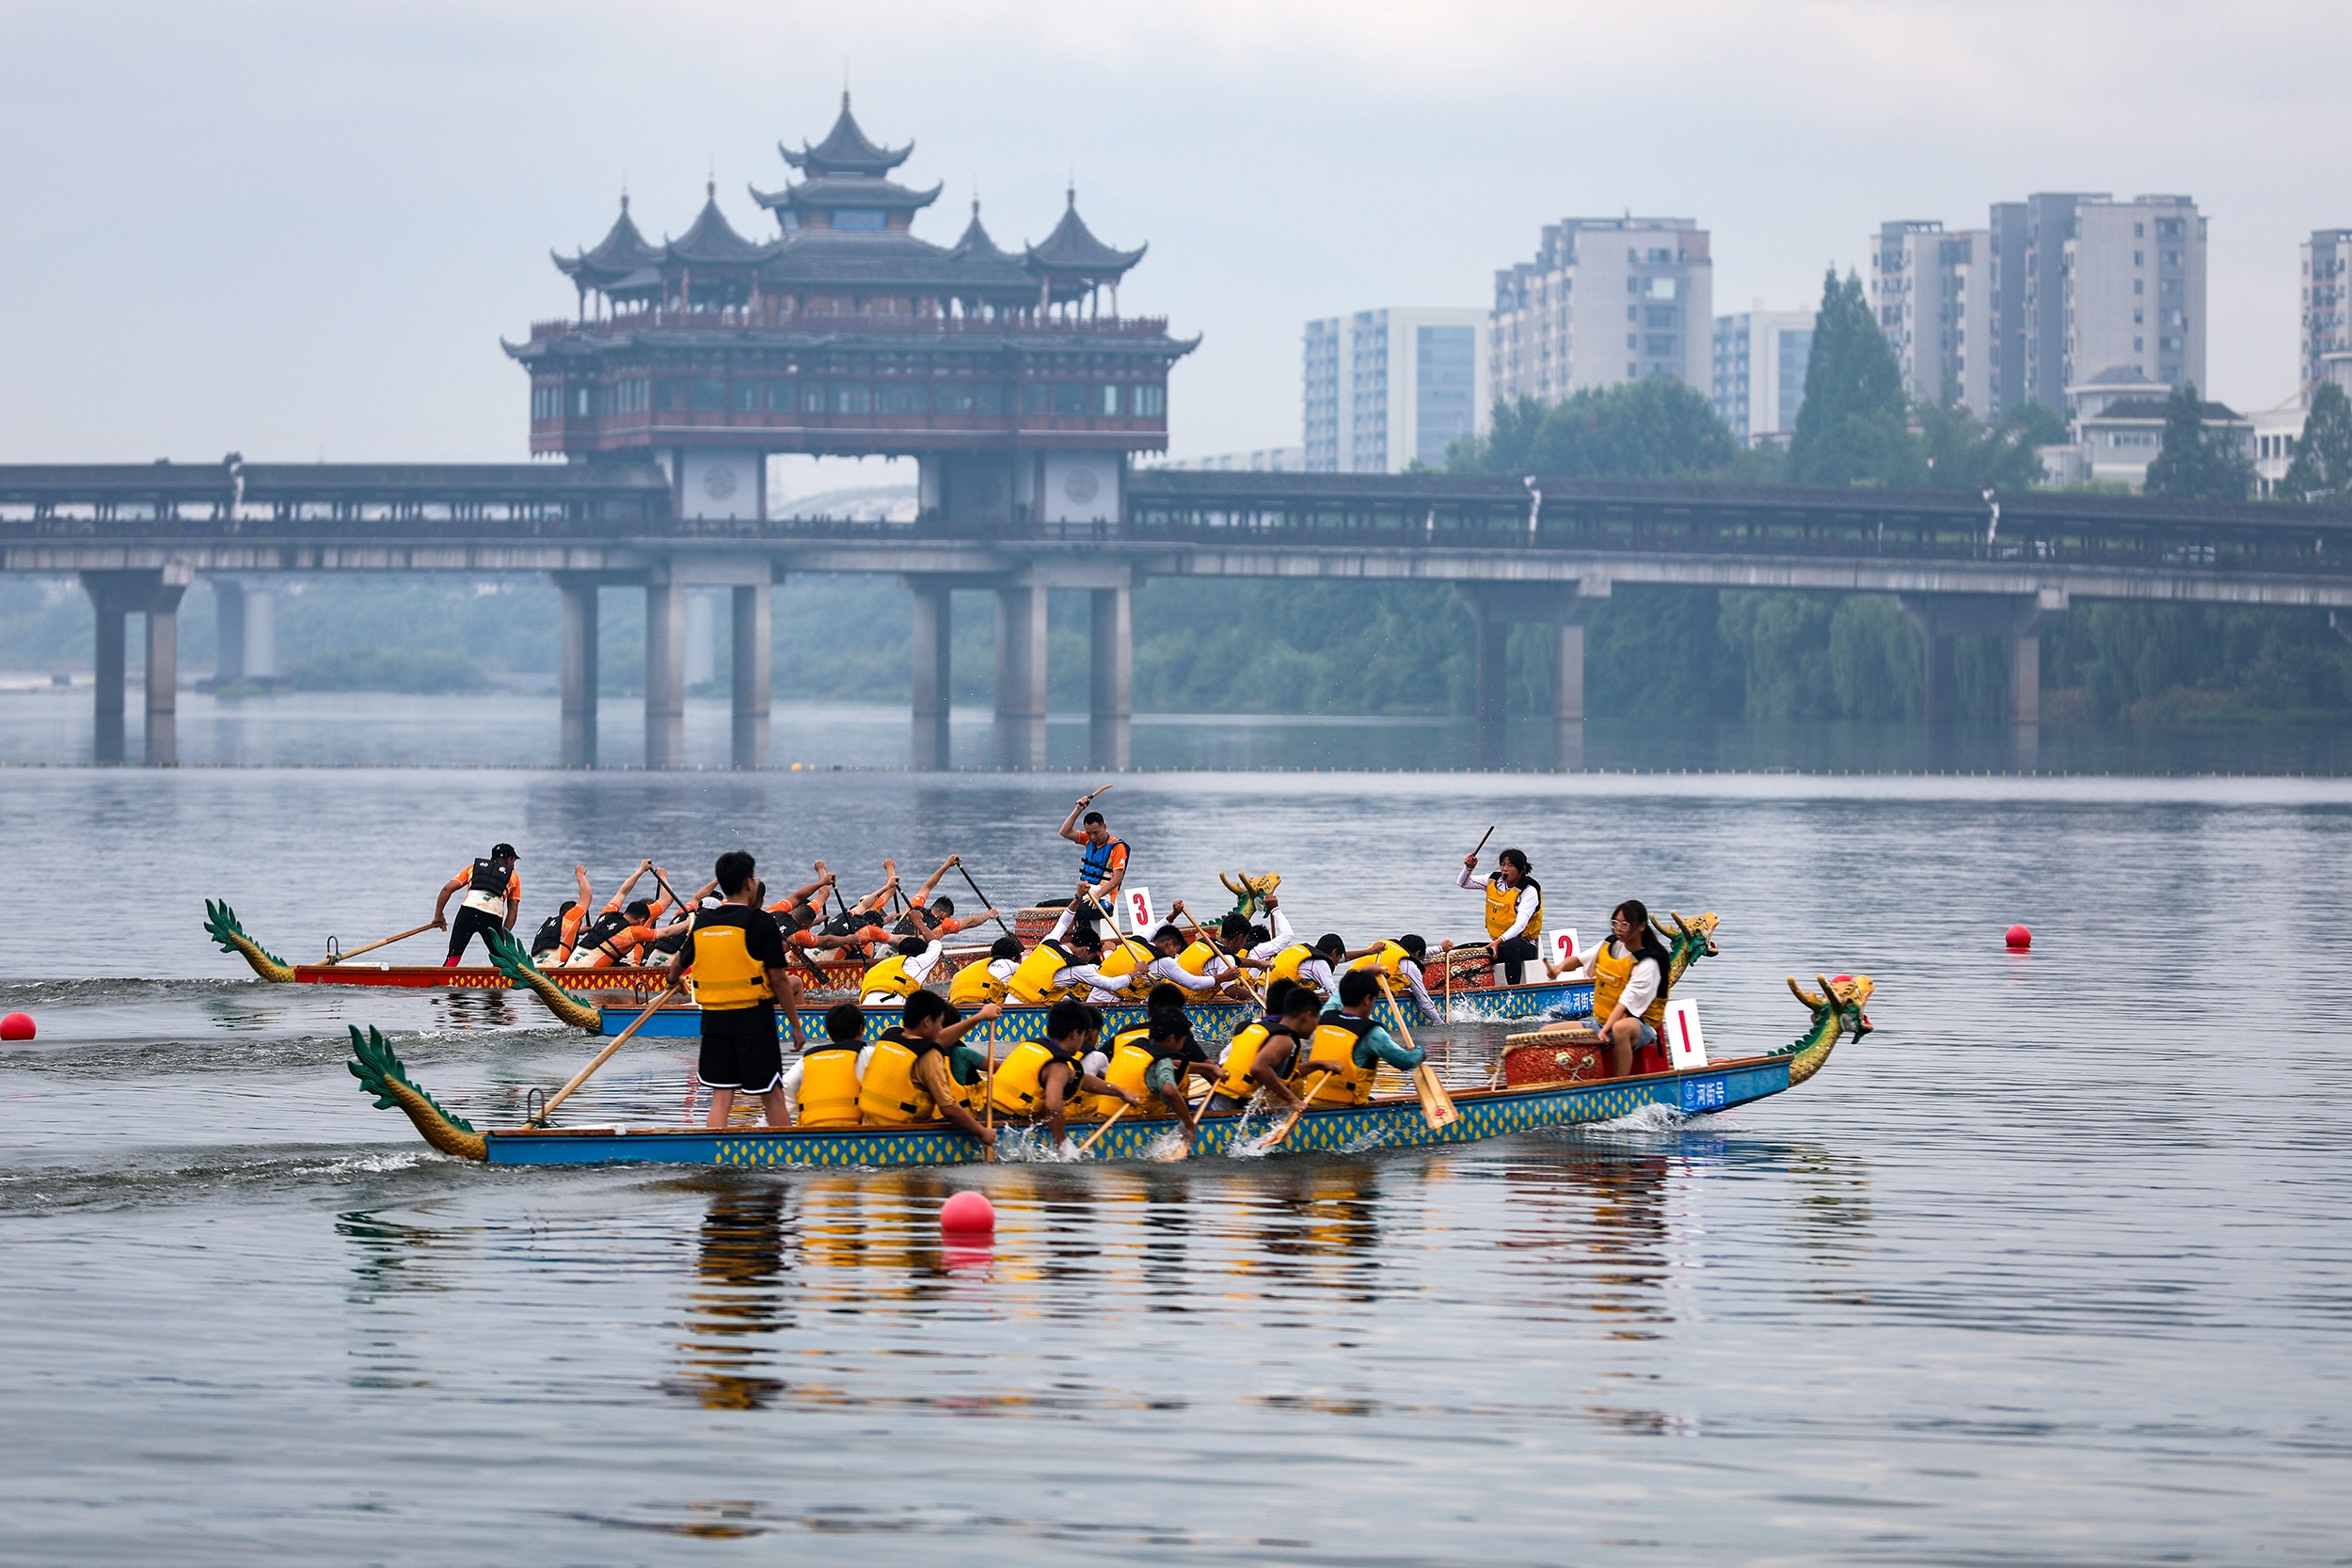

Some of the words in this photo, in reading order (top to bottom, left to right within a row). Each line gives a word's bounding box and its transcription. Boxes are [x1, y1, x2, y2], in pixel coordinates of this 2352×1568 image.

[1132, 893, 1149, 926] 3
[1558, 935, 1576, 971] 2
[1677, 1009, 1692, 1053] 1
[1695, 1081, 1725, 1106] 河街号
